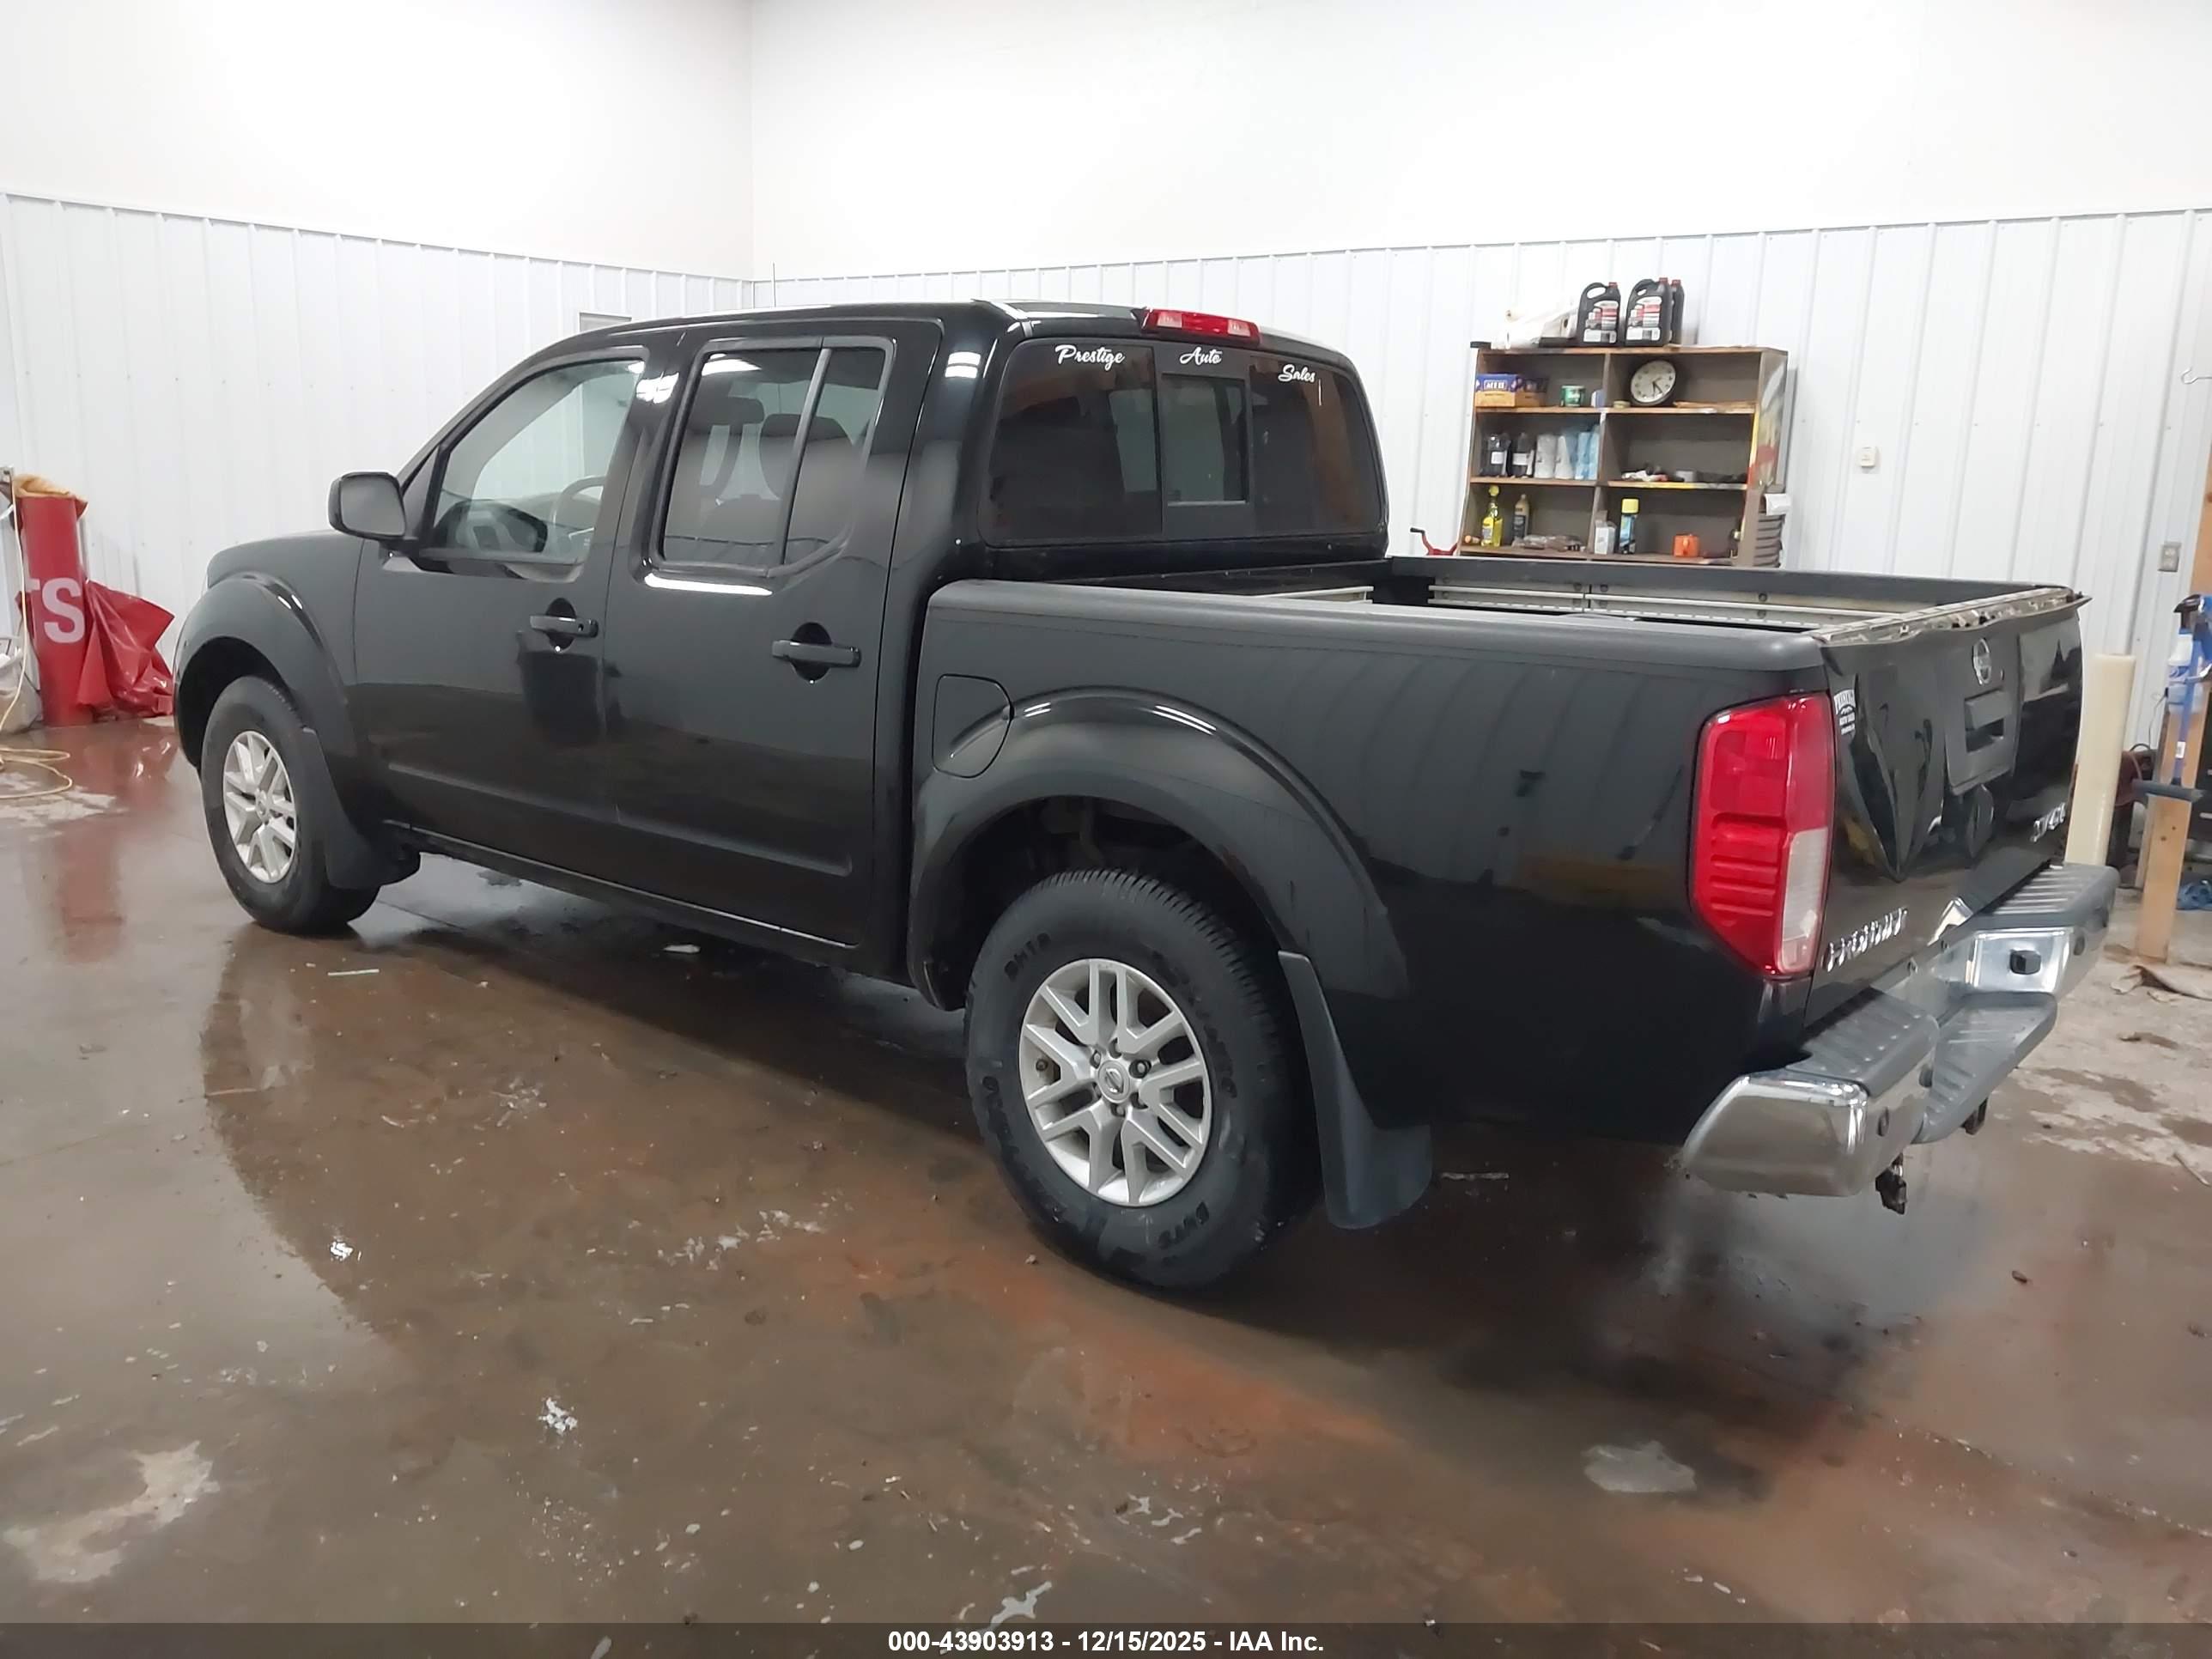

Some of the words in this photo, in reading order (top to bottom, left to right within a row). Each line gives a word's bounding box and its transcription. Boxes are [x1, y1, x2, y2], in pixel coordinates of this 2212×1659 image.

[1054, 344, 1126, 371] Prestige
[1179, 346, 1223, 366] Auto
[1278, 363, 1316, 383] Sales
